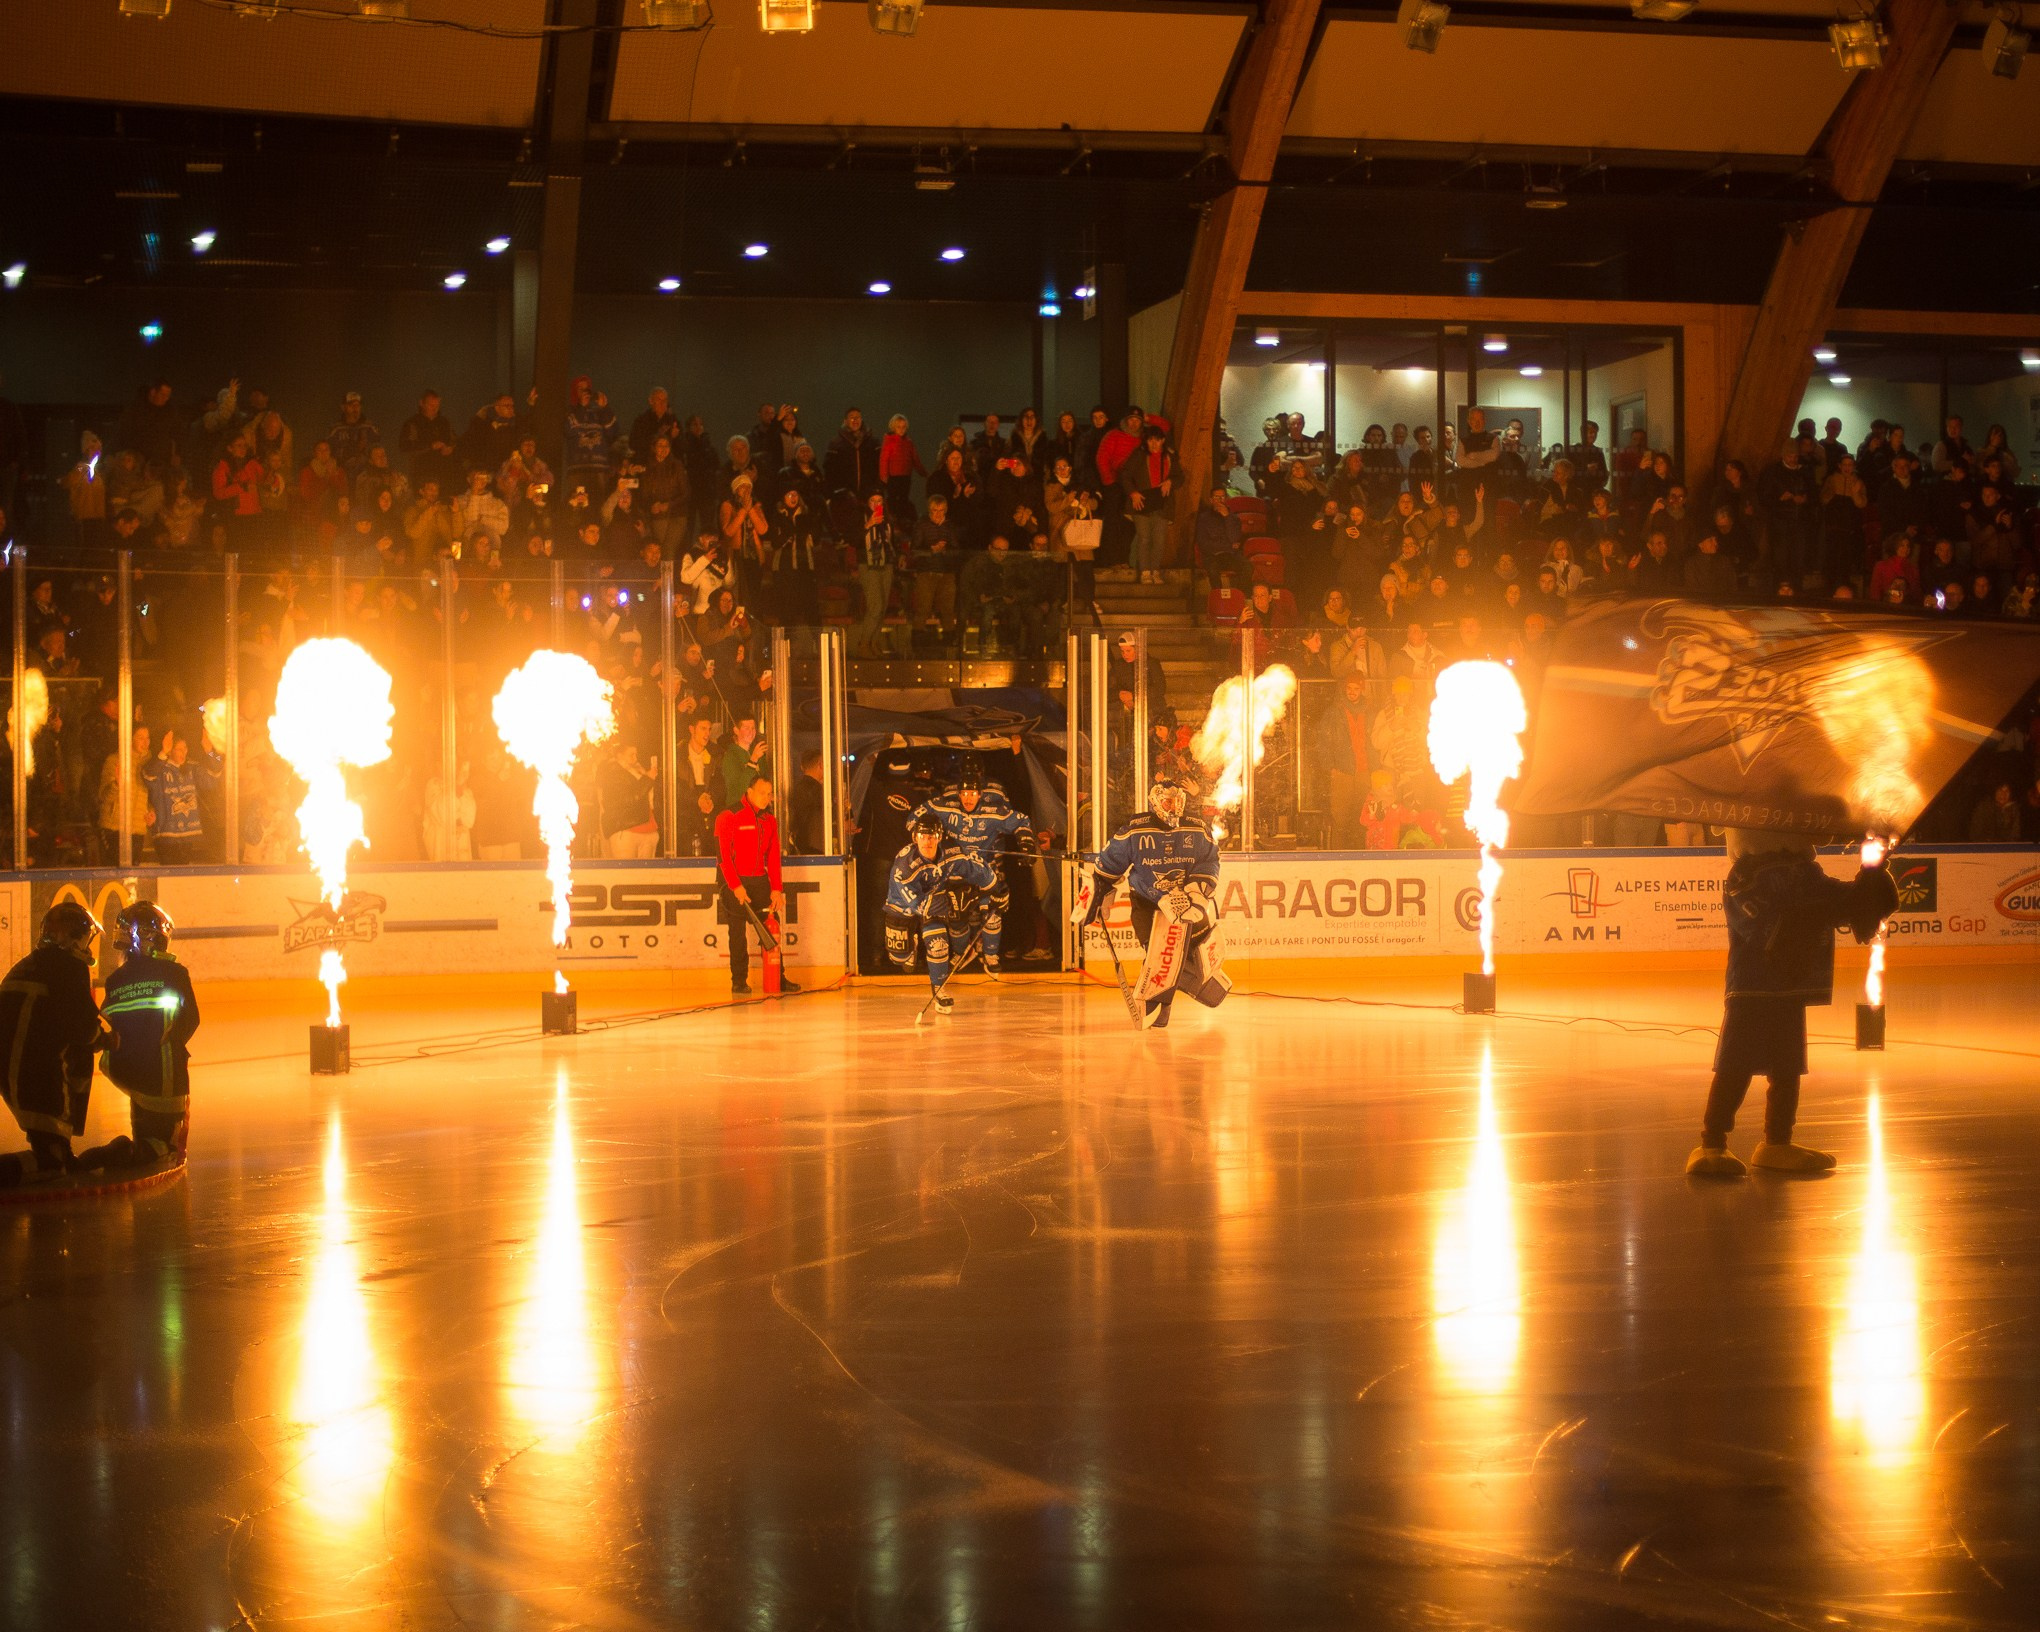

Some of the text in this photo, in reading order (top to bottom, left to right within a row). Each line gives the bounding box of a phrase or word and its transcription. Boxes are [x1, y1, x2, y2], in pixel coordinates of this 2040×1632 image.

[1141, 857, 1162, 866] Alpes
[1614, 880, 1728, 893] ALPES MATERIE
[1219, 878, 1426, 919] ARAGOR
[1654, 901, 1724, 913] Ensemble po
[1324, 918, 1427, 930] Expertise comptable
[1948, 915, 1986, 935] Gap
[885, 926, 908, 940] BFM
[1544, 925, 1621, 942] AMH
[703, 932, 798, 949] QD
[887, 939, 905, 950] DICI
[1244, 938, 1263, 946] GAP
[1282, 937, 1304, 945] FARE
[1312, 936, 1336, 945] PONT
[1338, 936, 1351, 944] DU
[1352, 934, 1380, 944] FOSSÉ
[1386, 935, 1426, 945] aragor.fr
